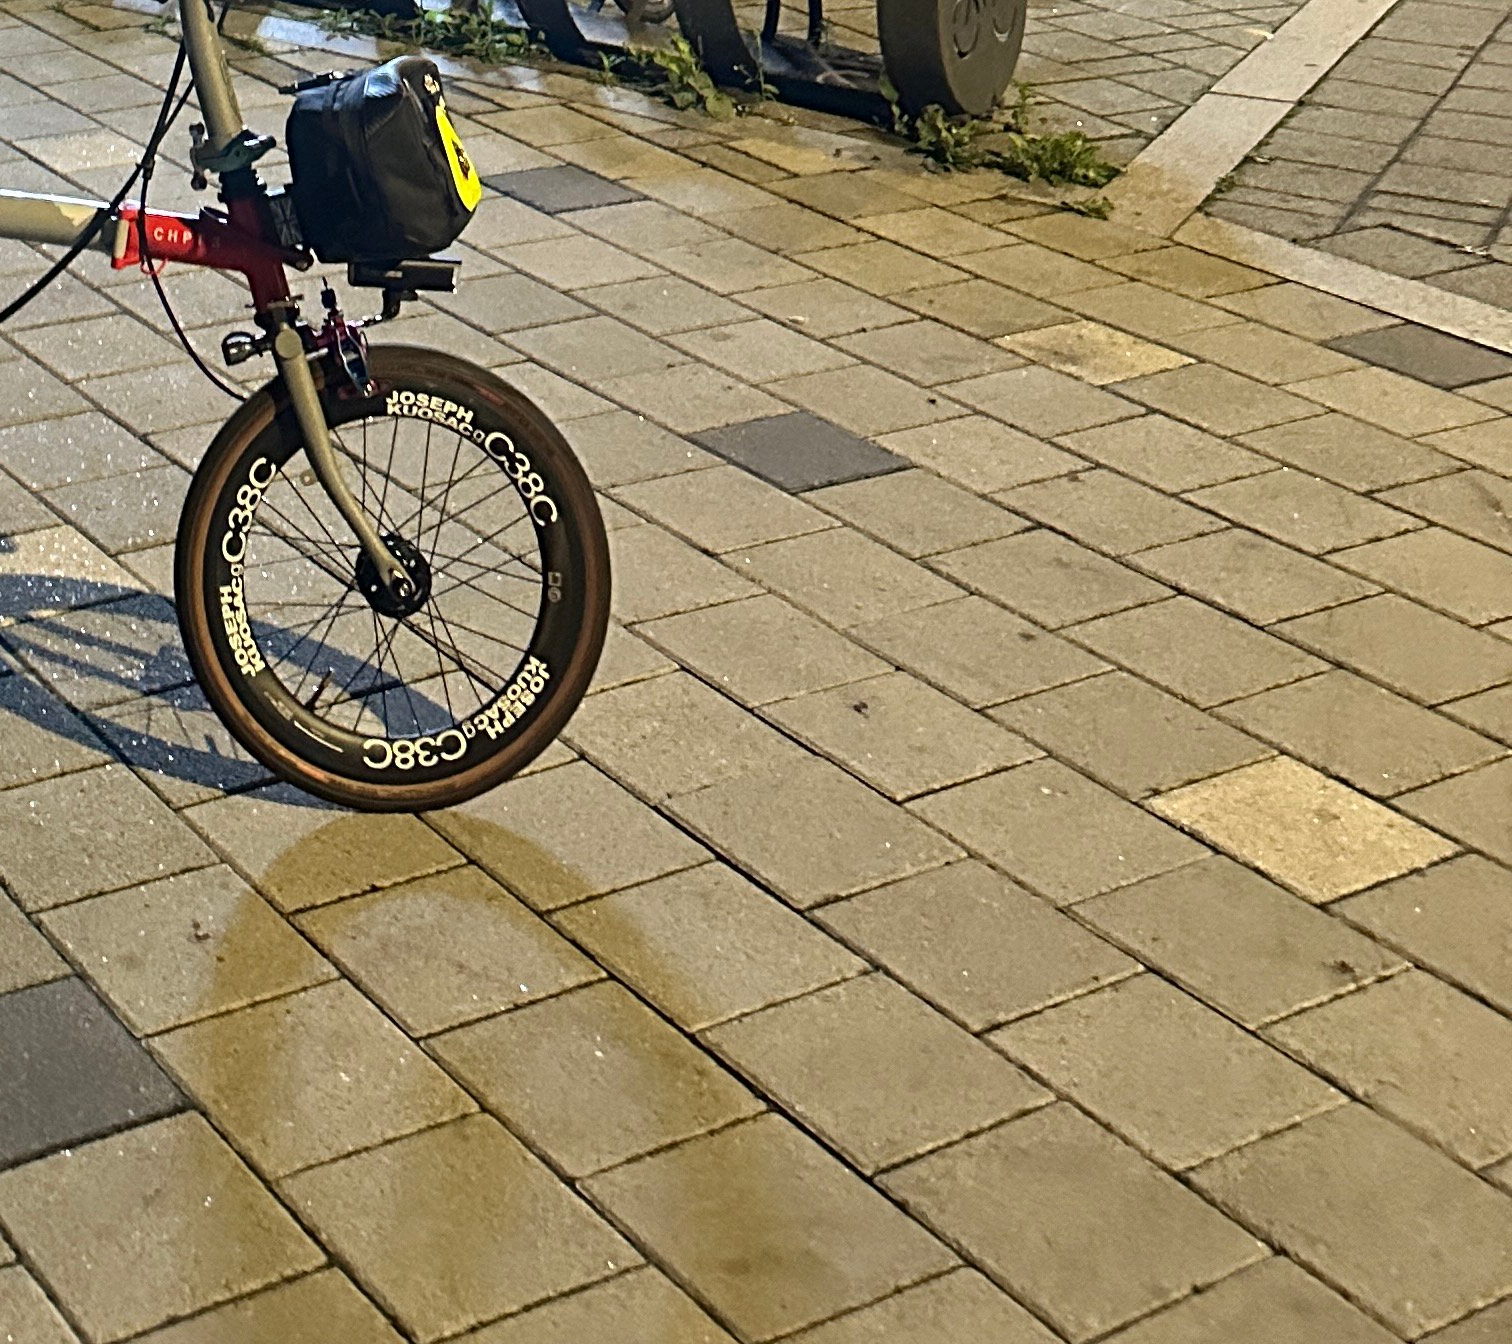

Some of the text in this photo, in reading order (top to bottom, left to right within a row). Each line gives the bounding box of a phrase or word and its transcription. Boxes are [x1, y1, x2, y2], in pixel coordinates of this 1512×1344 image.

[386, 390, 474, 424] JOSEPH
[222, 457, 277, 563] C38C
[484, 431, 558, 527] C38C
[219, 585, 257, 678] JOSEPH
[485, 663, 550, 740] JOSEPH
[363, 729, 467, 770] C38C
